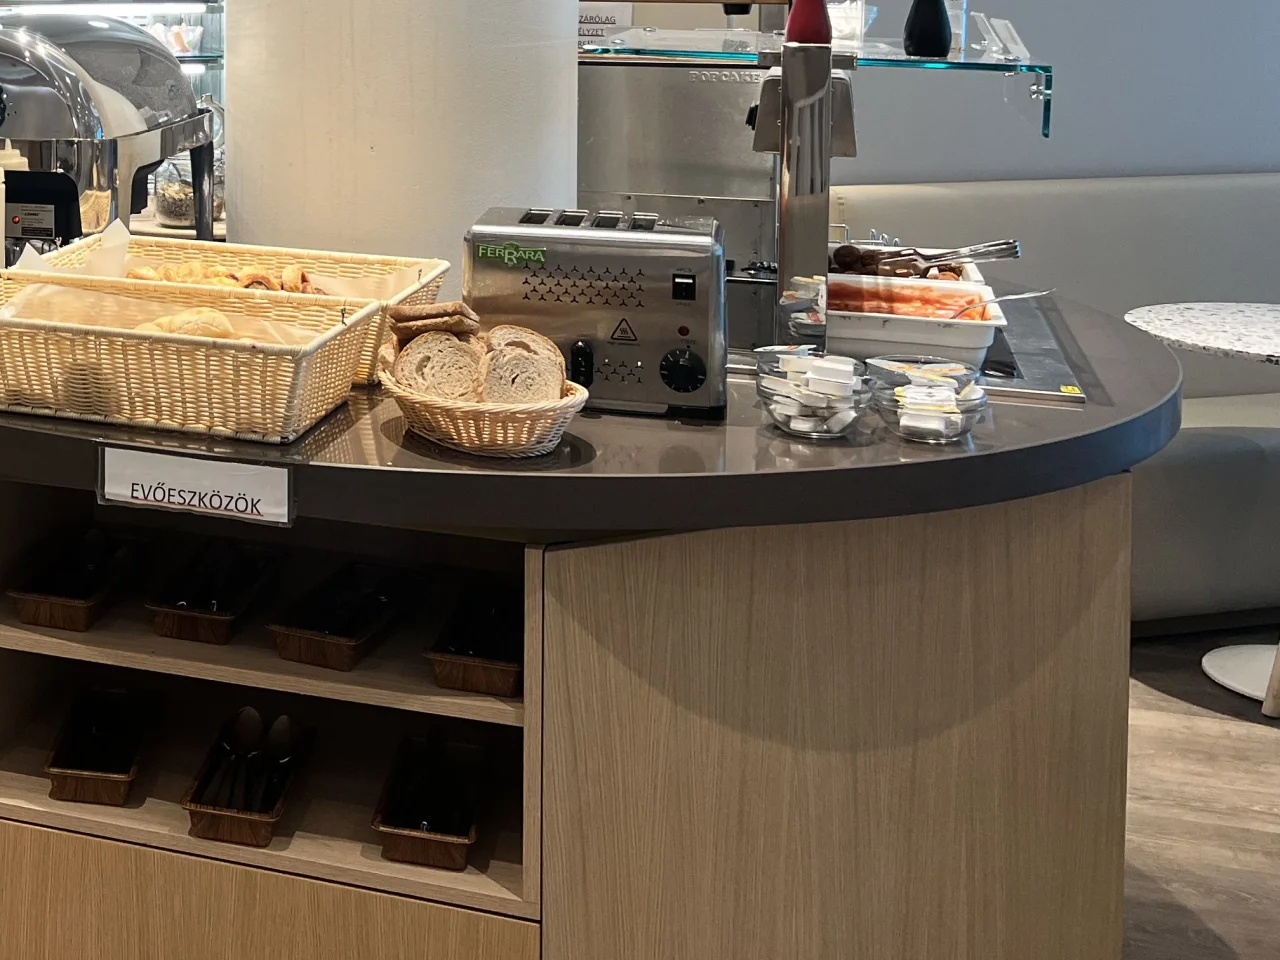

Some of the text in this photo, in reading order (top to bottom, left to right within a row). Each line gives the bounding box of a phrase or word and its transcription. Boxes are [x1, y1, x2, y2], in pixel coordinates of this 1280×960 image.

[689, 71, 762, 84] POPCAKE
[478, 245, 545, 264] FERRARA
[131, 482, 262, 515] EVŐESZKÖZÖK
